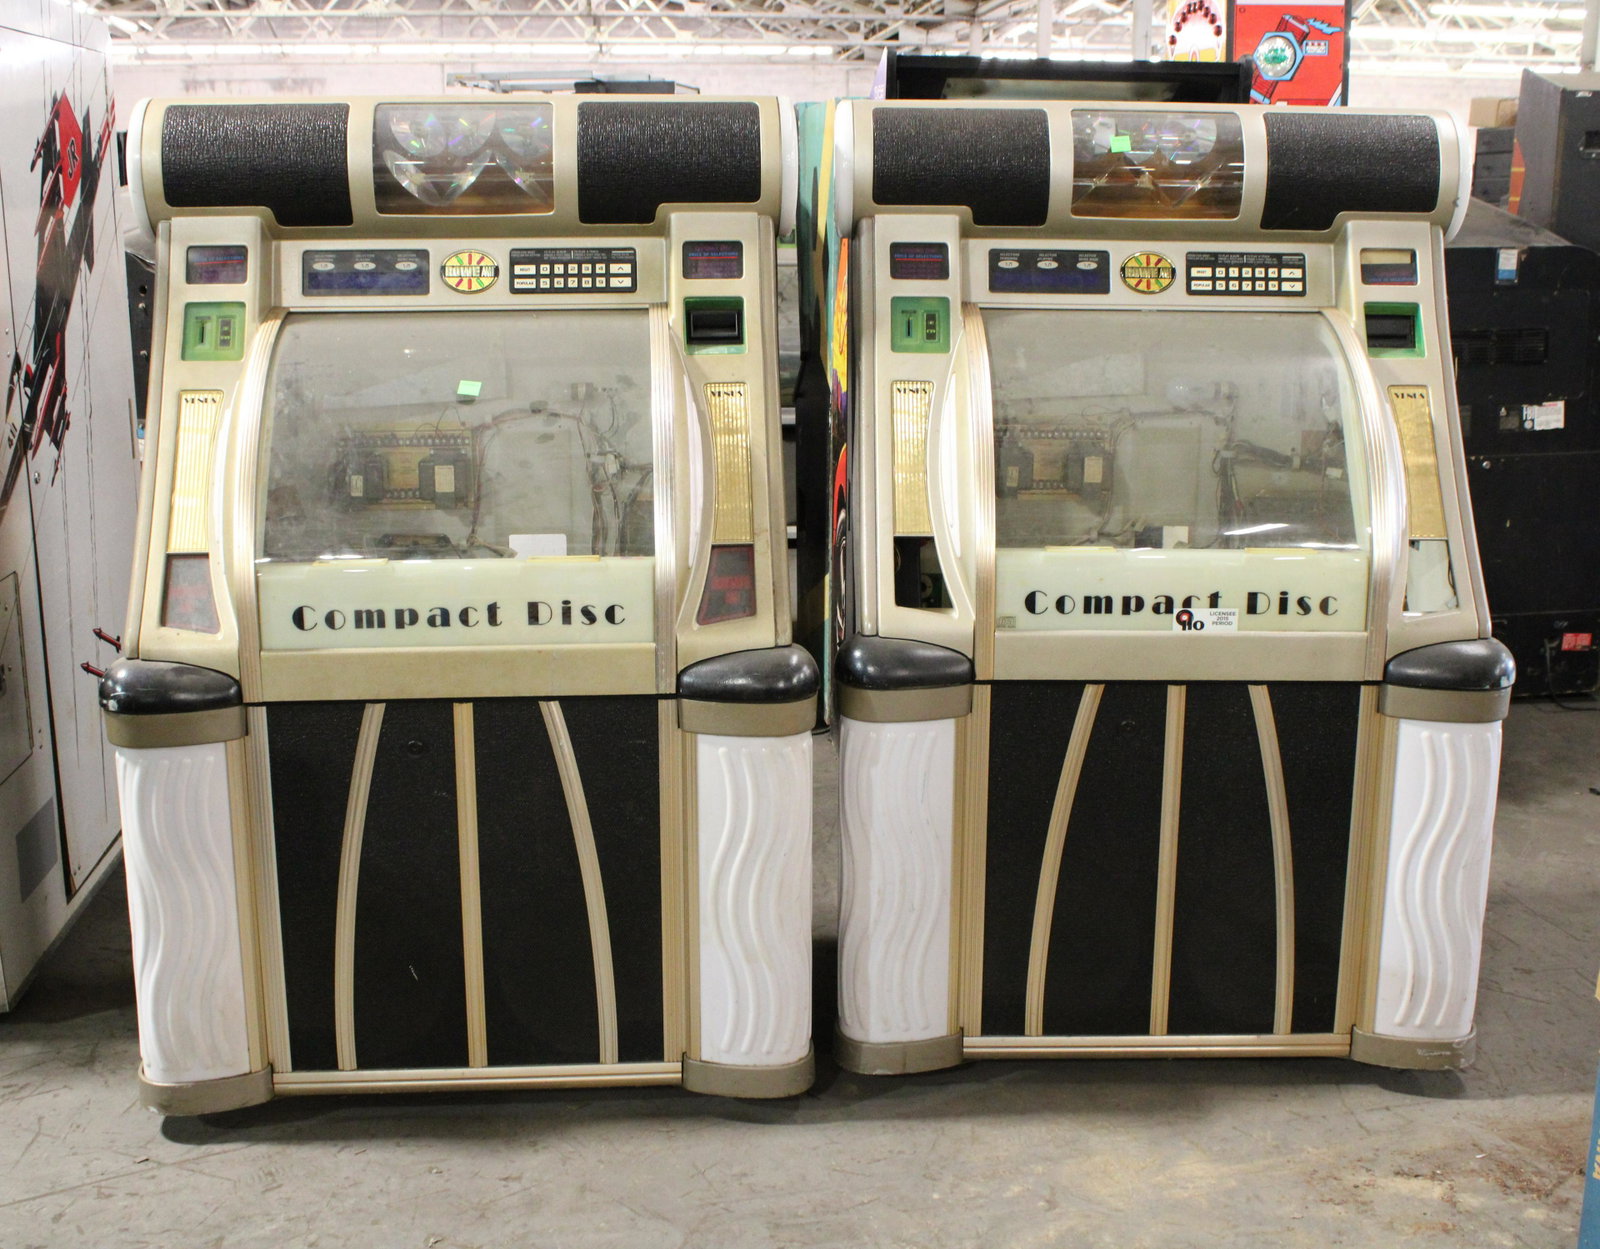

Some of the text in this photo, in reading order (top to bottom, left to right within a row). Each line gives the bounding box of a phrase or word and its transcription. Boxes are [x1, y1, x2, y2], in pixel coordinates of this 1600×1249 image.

[67, 137, 79, 180] JR
[292, 600, 626, 631] Compact Disc
[1025, 590, 1338, 616] Compact Disc
